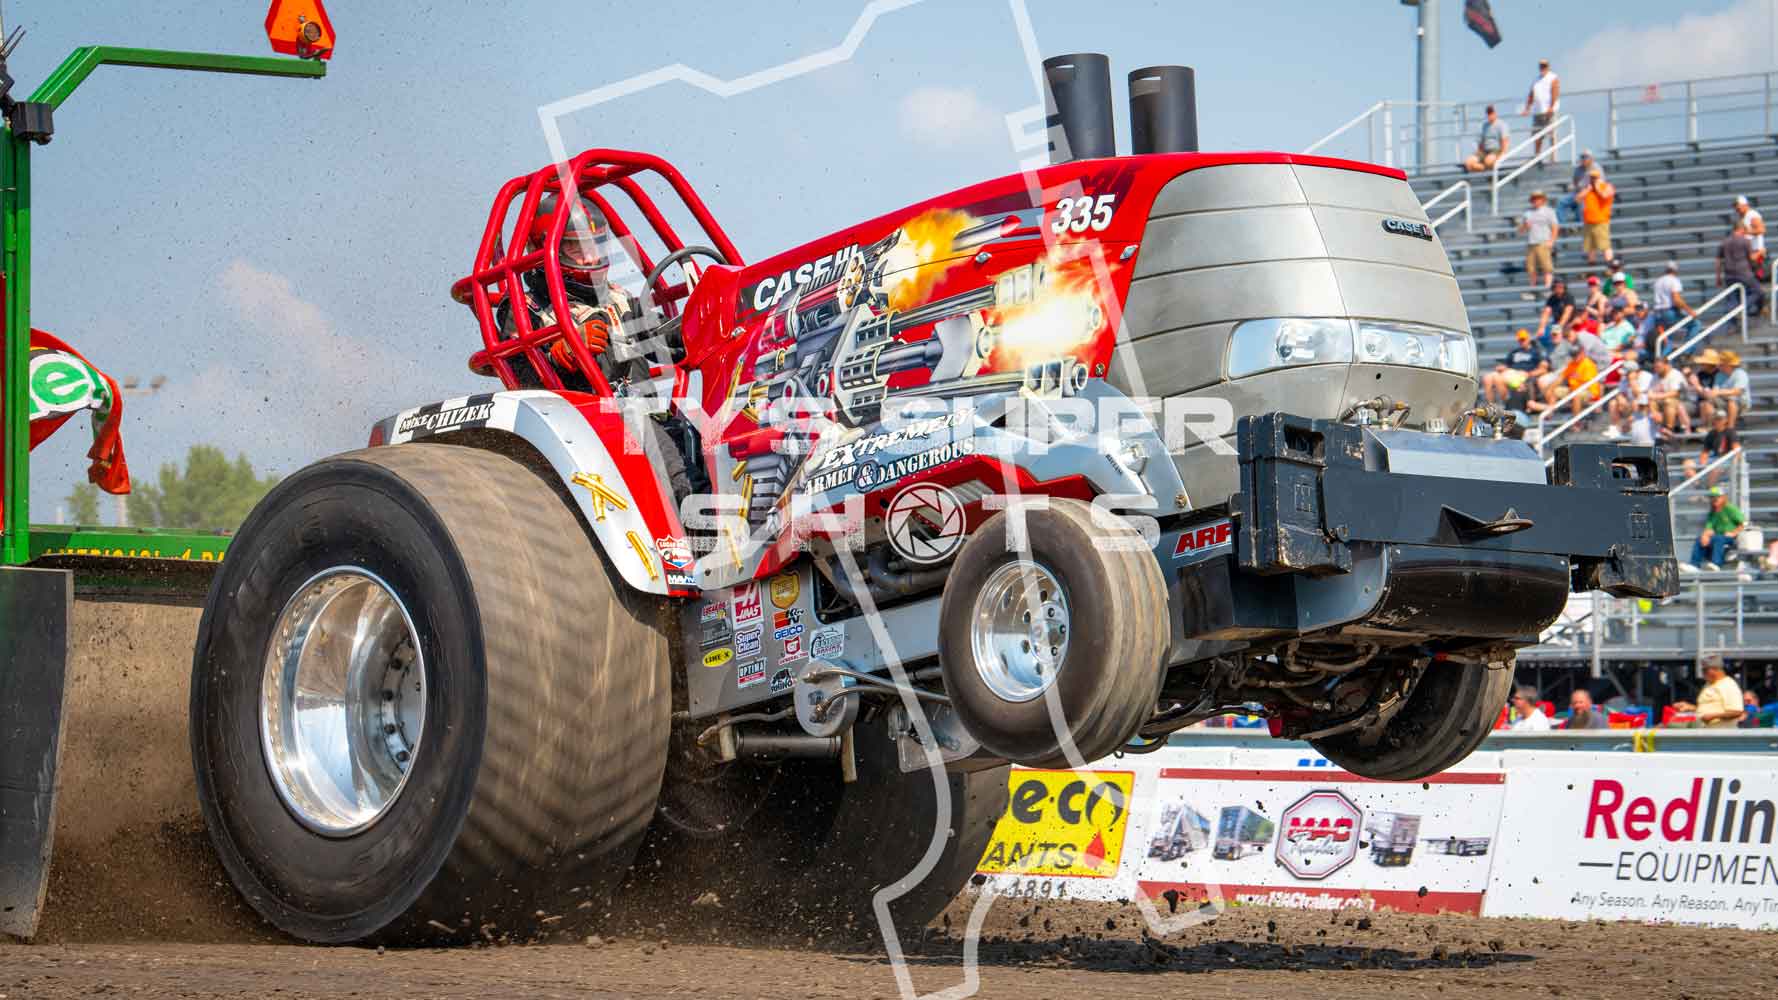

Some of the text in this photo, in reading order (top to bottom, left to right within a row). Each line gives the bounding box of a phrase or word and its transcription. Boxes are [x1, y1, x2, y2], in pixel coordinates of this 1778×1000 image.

[1051, 193, 1116, 234] 335
[1387, 219, 1420, 234] CASE
[753, 254, 834, 311] CASE
[399, 413, 430, 434] MIKE
[876, 437, 975, 484] DANGEROUS
[775, 625, 803, 640] GEICO
[1288, 817, 1353, 842] MAC
[1573, 891, 1595, 911] Any
[1652, 894, 1678, 913] Any
[1735, 897, 1760, 917] Any
